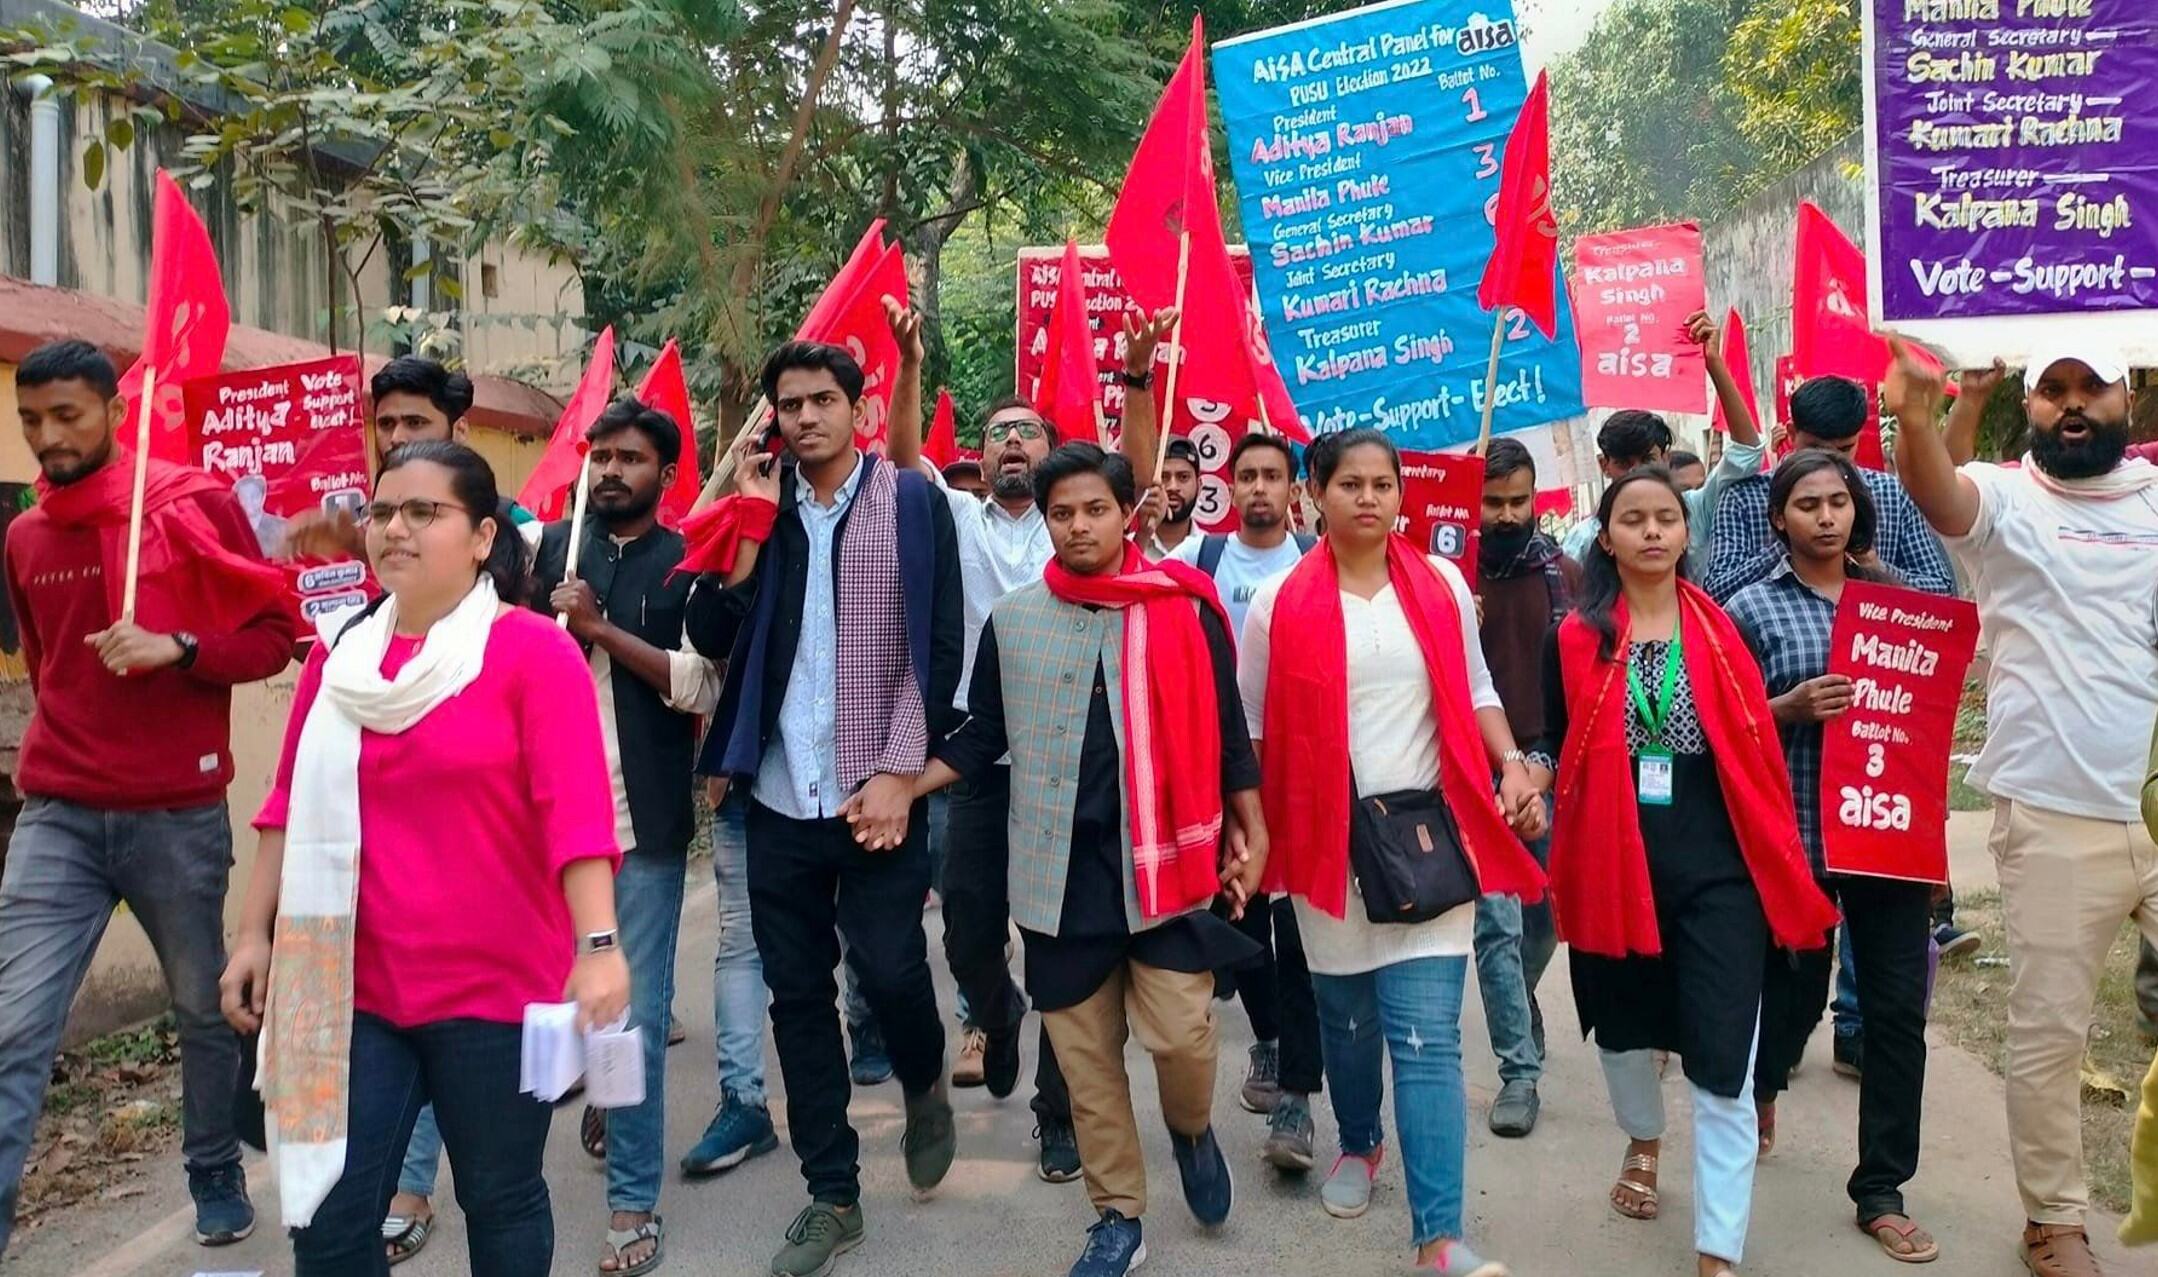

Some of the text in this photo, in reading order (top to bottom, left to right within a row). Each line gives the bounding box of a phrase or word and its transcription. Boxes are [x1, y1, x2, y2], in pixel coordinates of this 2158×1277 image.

[1308, 36, 1378, 72] Central
[1380, 26, 1429, 57] Panel
[1459, 22, 1514, 53] aisa
[1911, 28, 1976, 48] General
[1290, 56, 1432, 107] PUSU Election 2022
[1438, 63, 1501, 90] Ballot No.
[1906, 50, 2102, 83] Sachin Kumar
[1274, 104, 1337, 132] President
[1462, 87, 1488, 123] 1
[1924, 89, 1975, 113] Joint
[1252, 130, 1331, 164] Aditya
[1336, 111, 1413, 147] Ranjan
[1908, 113, 2123, 150] Kumari Rachna
[1264, 152, 1361, 187] Vice President
[1473, 143, 1499, 179] 3
[1261, 174, 1390, 219] Manila Phule
[1273, 203, 1393, 241] General Secretary
[1915, 192, 2132, 238] Kalpana Singh
[1270, 215, 1434, 268] Sachin Kumar
[1286, 251, 1396, 288] Joint Secretary
[1584, 257, 1687, 285] Kalpana
[1282, 269, 1448, 322] Kumari Rachna
[1298, 320, 1381, 349] Treasurer
[1505, 308, 1530, 341] 2
[1624, 322, 1641, 345] 2
[1296, 329, 1454, 386] Kalpana Singh
[1597, 347, 1673, 378] aisa
[219, 379, 290, 404] President
[301, 371, 343, 392] Vote
[303, 389, 356, 411] Support
[201, 400, 292, 436] Aditya
[203, 437, 296, 475] Ranjan
[1199, 433, 1218, 460] 6
[1200, 485, 1219, 513] 3
[1437, 525, 1458, 554] 6
[1859, 602, 1953, 632] Vice President
[1851, 633, 1939, 677] Manila
[1853, 678, 1913, 714] Phule
[1852, 720, 1909, 744] Ballot No.
[1865, 743, 1885, 777] 3
[1839, 784, 1911, 832] aisa
